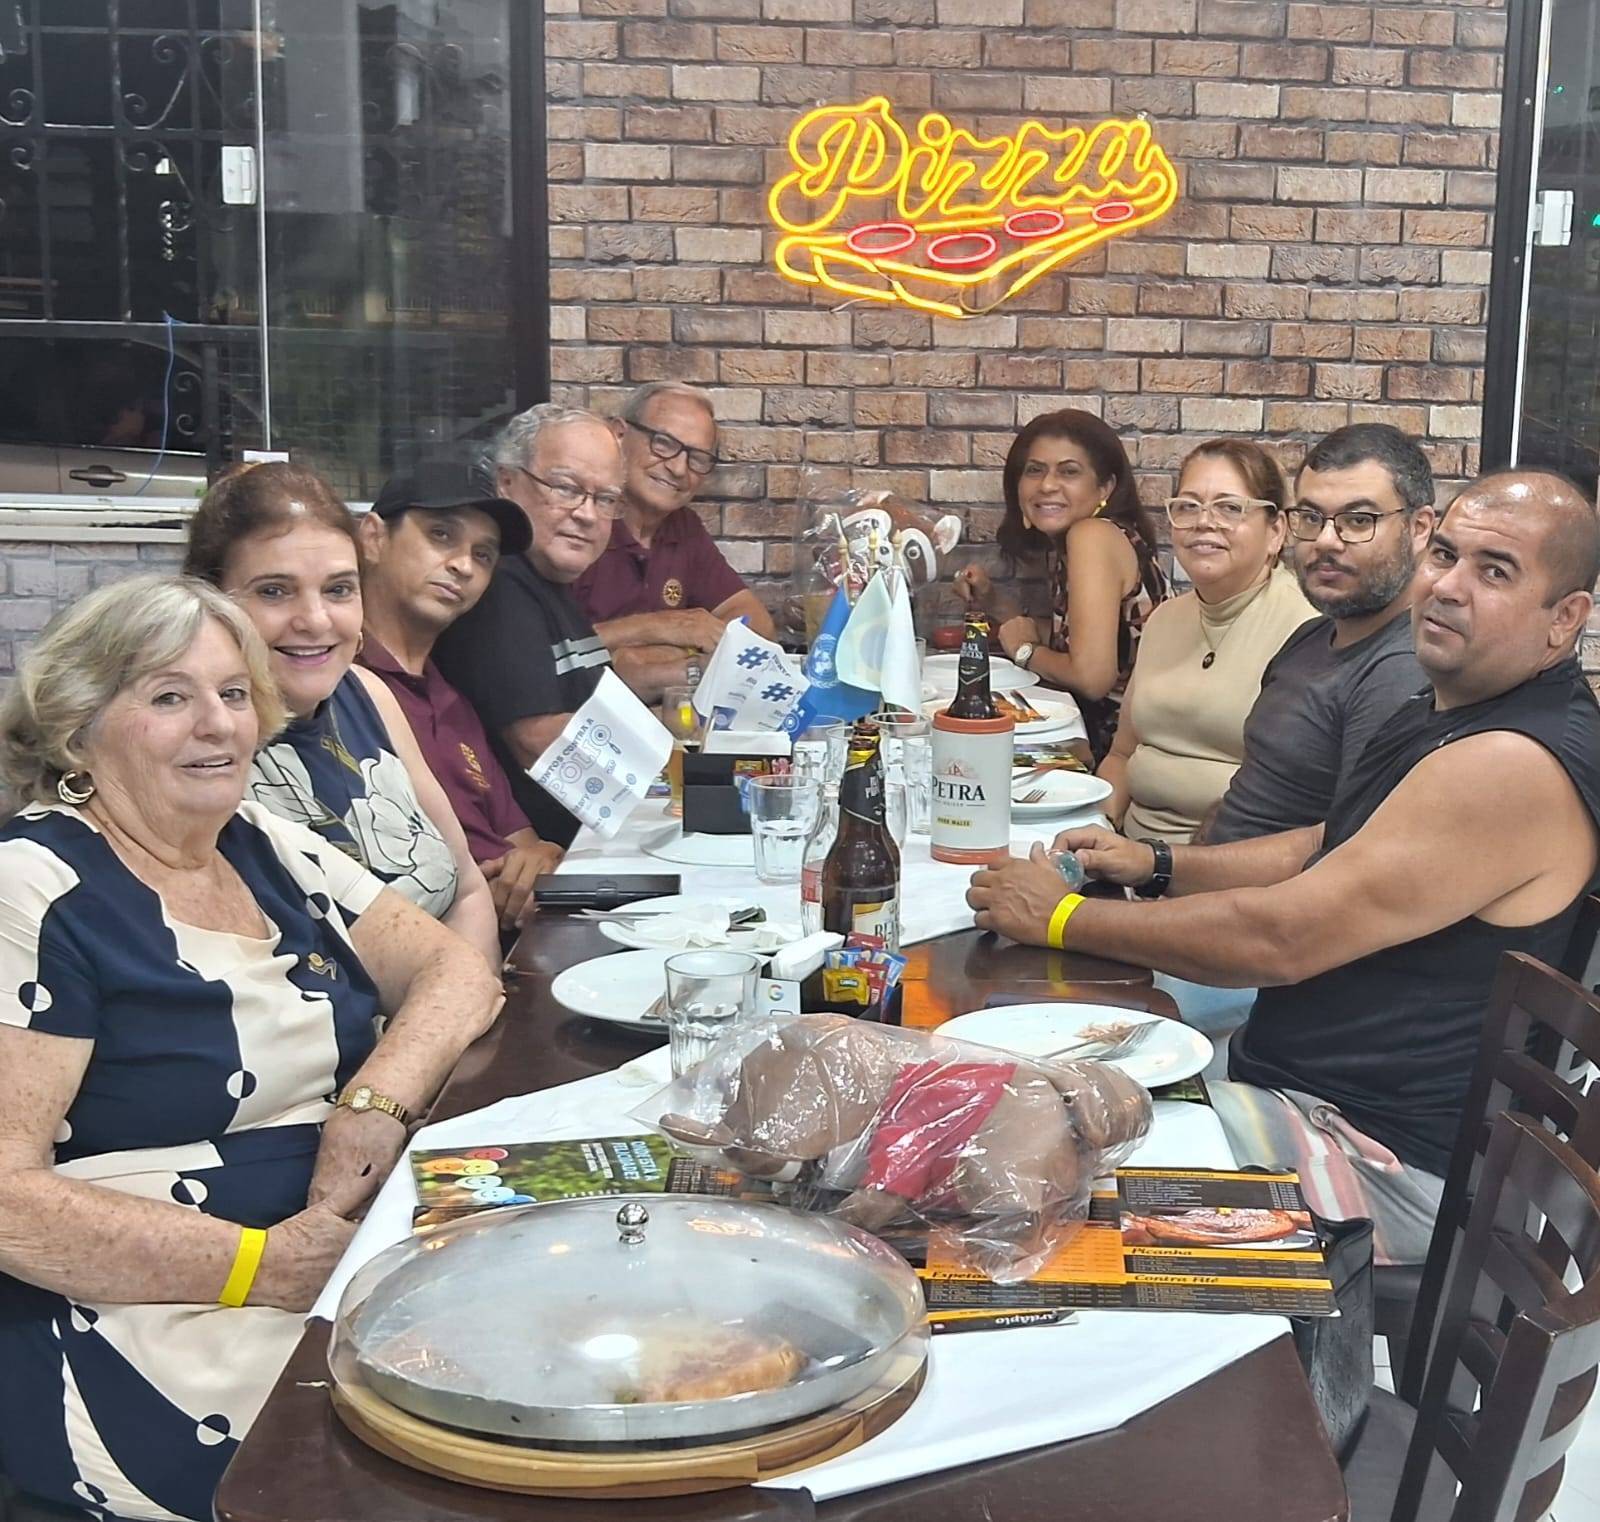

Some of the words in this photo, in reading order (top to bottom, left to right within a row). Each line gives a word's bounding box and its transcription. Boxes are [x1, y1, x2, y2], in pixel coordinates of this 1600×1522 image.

[782, 96, 1174, 222] Pizza
[563, 725, 588, 757] CONTRA
[932, 775, 986, 801] PETRA
[1131, 1247, 1193, 1257] Picanha
[1134, 1274, 1188, 1284] Contra
